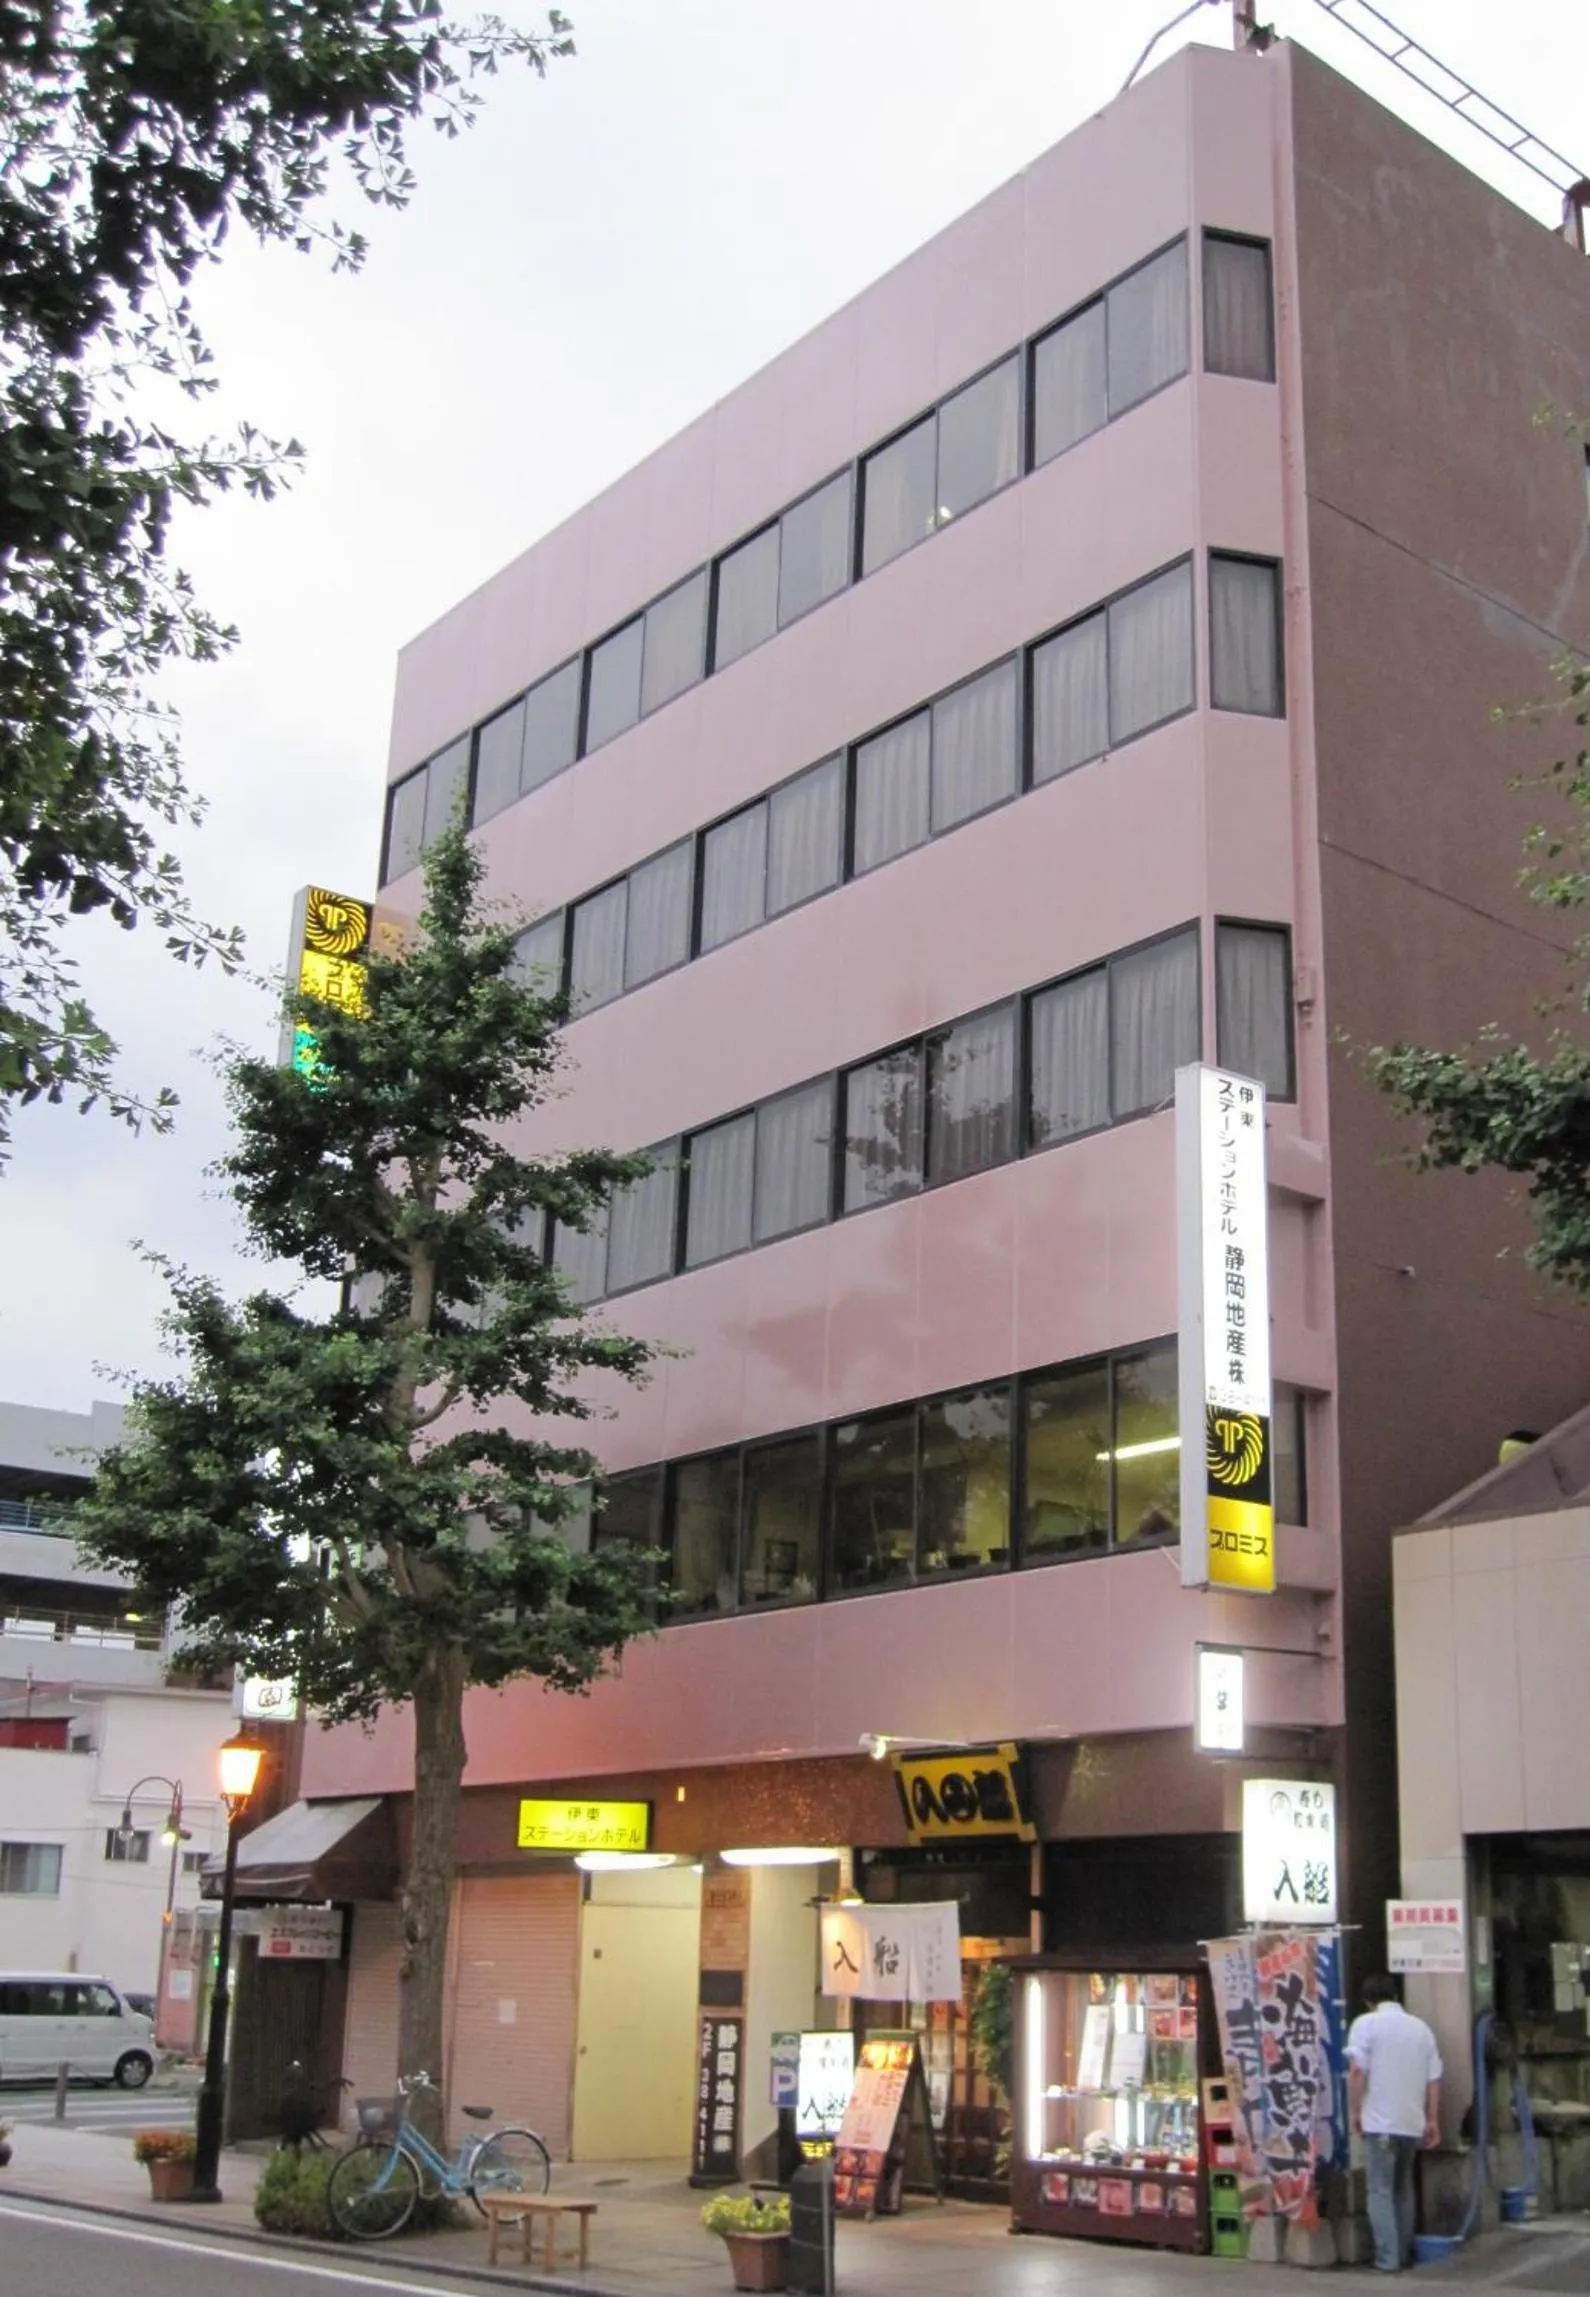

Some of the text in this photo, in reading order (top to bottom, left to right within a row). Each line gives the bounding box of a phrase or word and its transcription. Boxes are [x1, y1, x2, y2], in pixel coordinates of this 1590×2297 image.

[1239, 1086, 1254, 1127] 伊東
[1218, 1077, 1238, 1236] ステーションホテル
[1208, 1527, 1269, 1557] プロミス
[567, 1806, 601, 1821] 伊東
[523, 1825, 642, 1844] ステーションホテル
[772, 2066, 797, 2105] P
